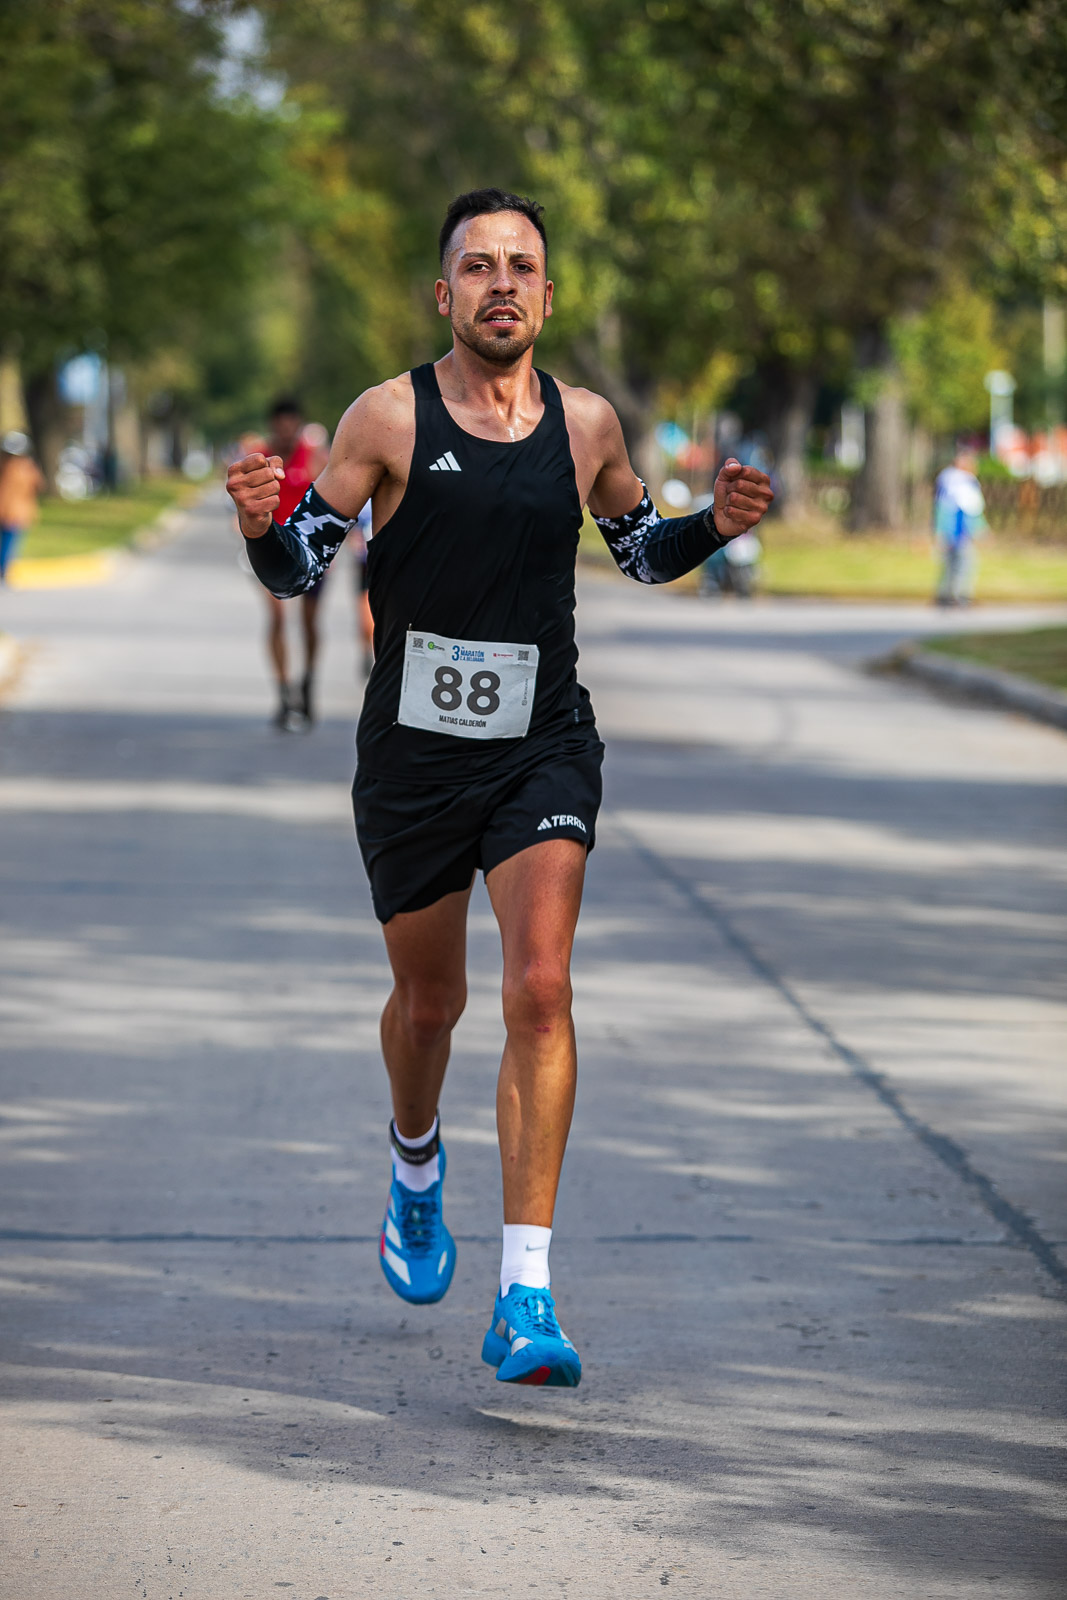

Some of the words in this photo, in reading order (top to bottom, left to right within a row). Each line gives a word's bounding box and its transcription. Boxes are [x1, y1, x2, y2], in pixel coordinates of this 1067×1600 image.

[451, 645, 460, 661] 3
[460, 649, 485, 657] MARATÓN
[431, 665, 501, 716] 88
[438, 714, 458, 725] MATIAS
[458, 718, 487, 728] CALDERÓN
